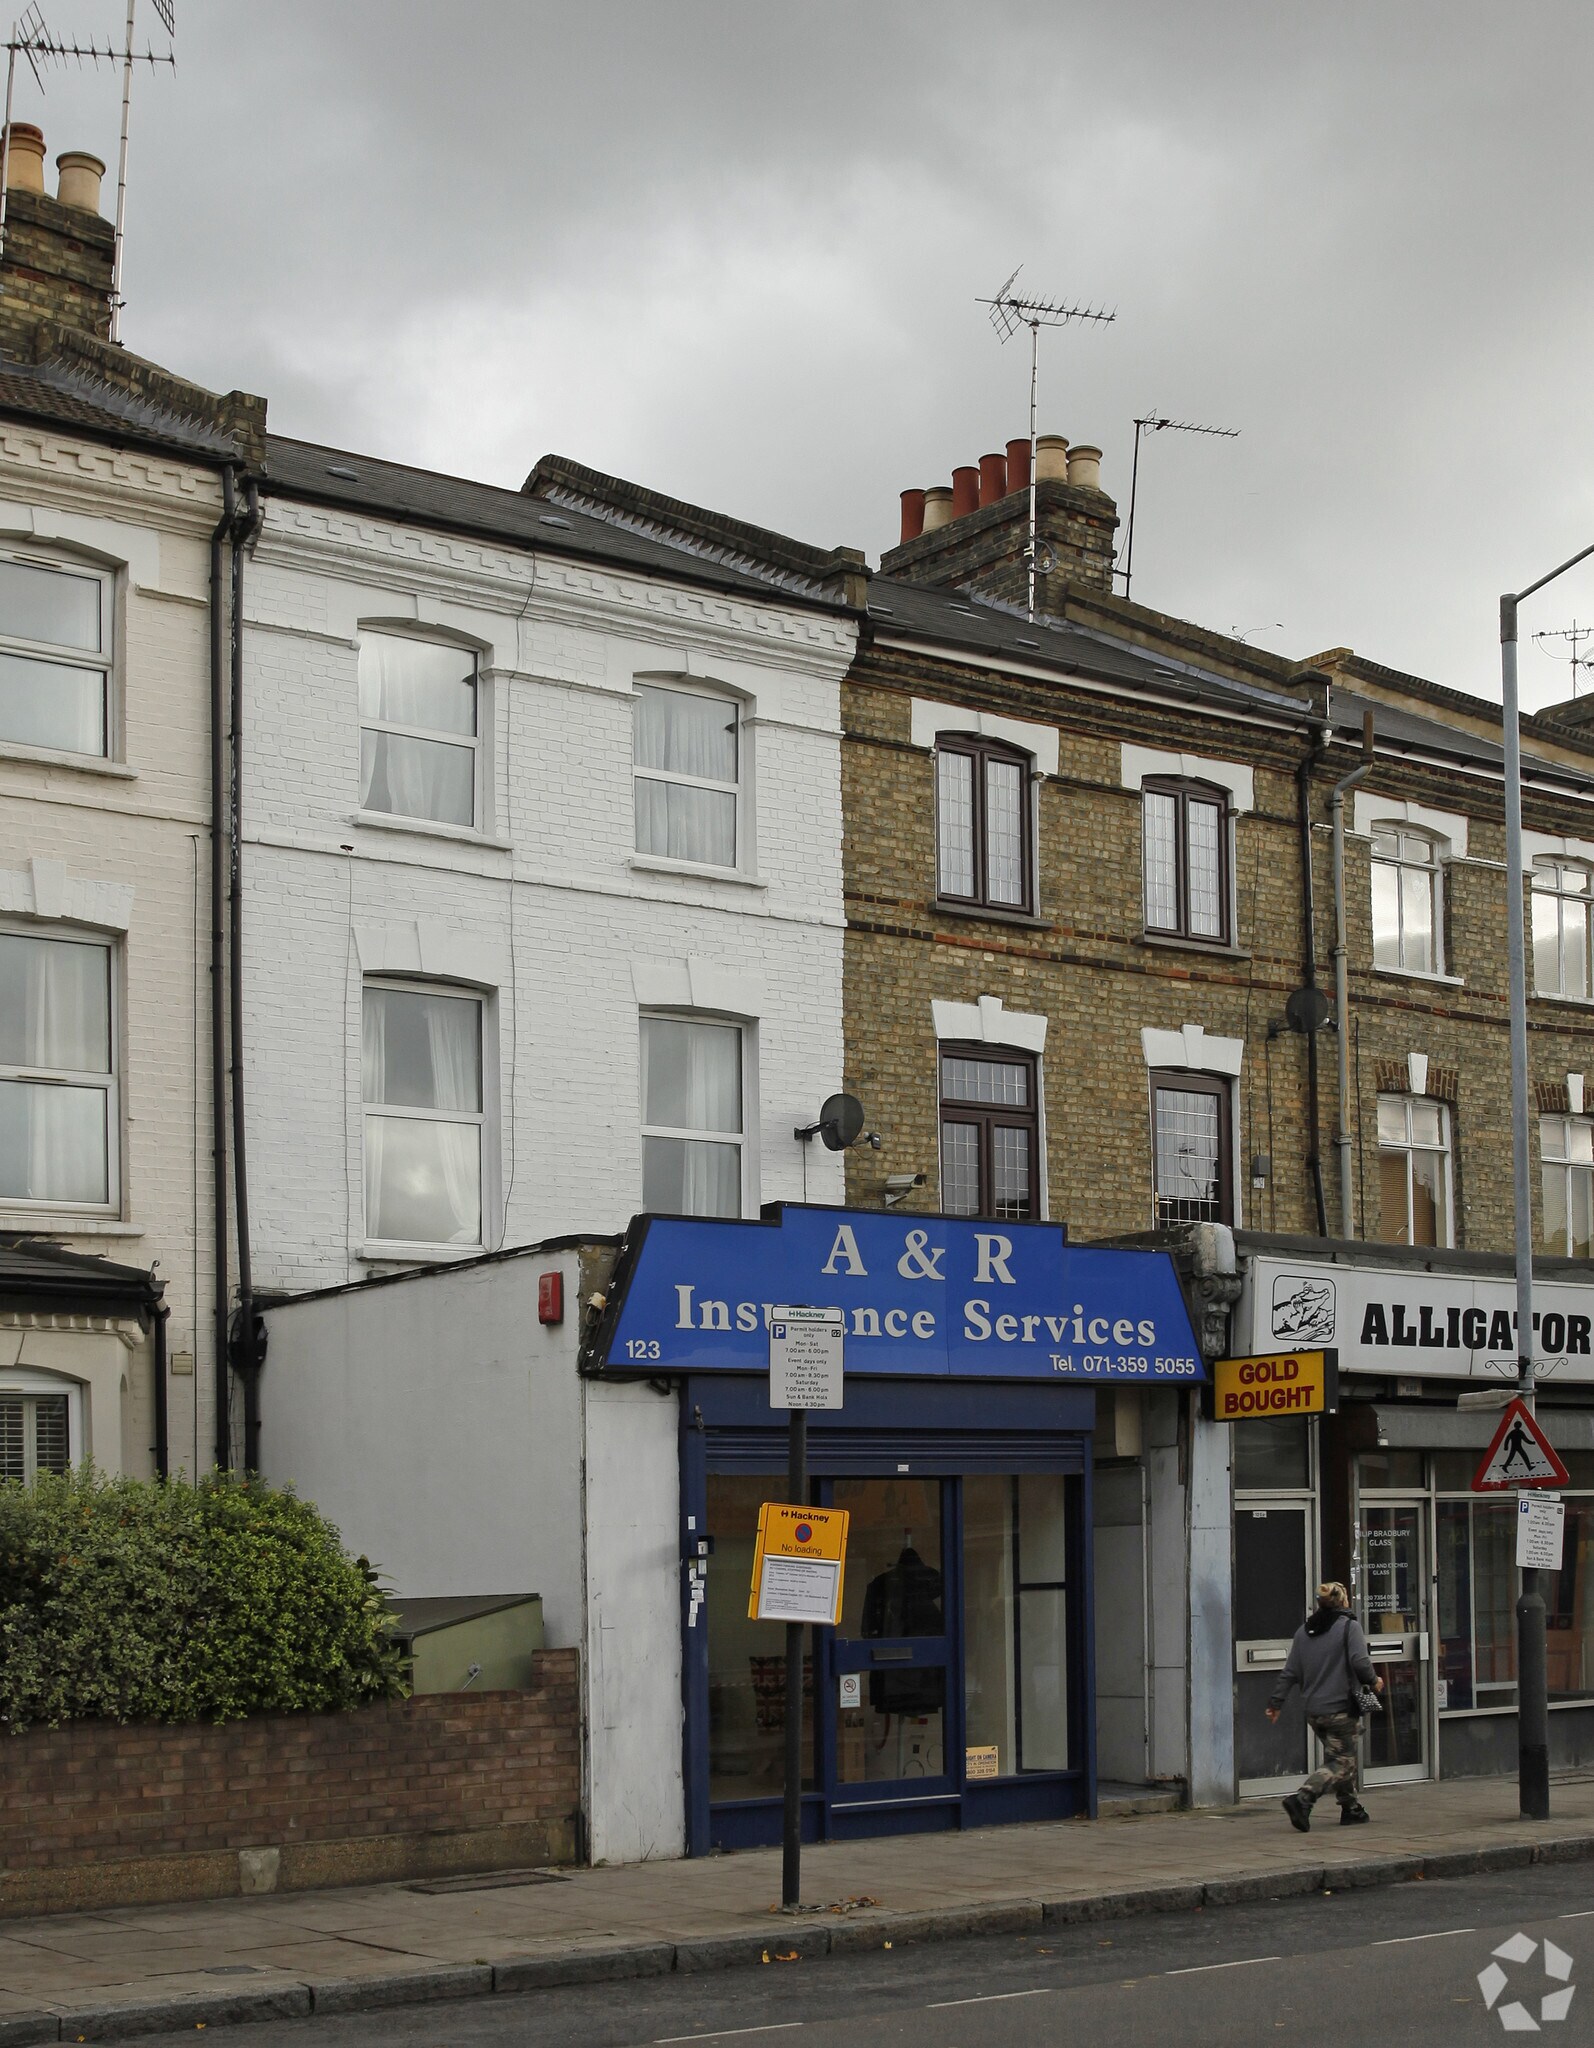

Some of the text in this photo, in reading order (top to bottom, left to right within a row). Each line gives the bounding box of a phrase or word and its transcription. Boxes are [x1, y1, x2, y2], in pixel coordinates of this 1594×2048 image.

[821, 1224, 1016, 1284] A & R
[674, 1285, 1156, 1346] Insnce Services
[796, 1311, 826, 1319] Hackney
[776, 1325, 784, 1338] P
[626, 1340, 660, 1359] 123
[1050, 1354, 1195, 1375] Tel. 071-359 5055
[1239, 1360, 1299, 1385] GOLD
[1225, 1386, 1314, 1414] BOUGHT
[791, 1510, 829, 1523] Hackney
[781, 1544, 822, 1556] No loading
